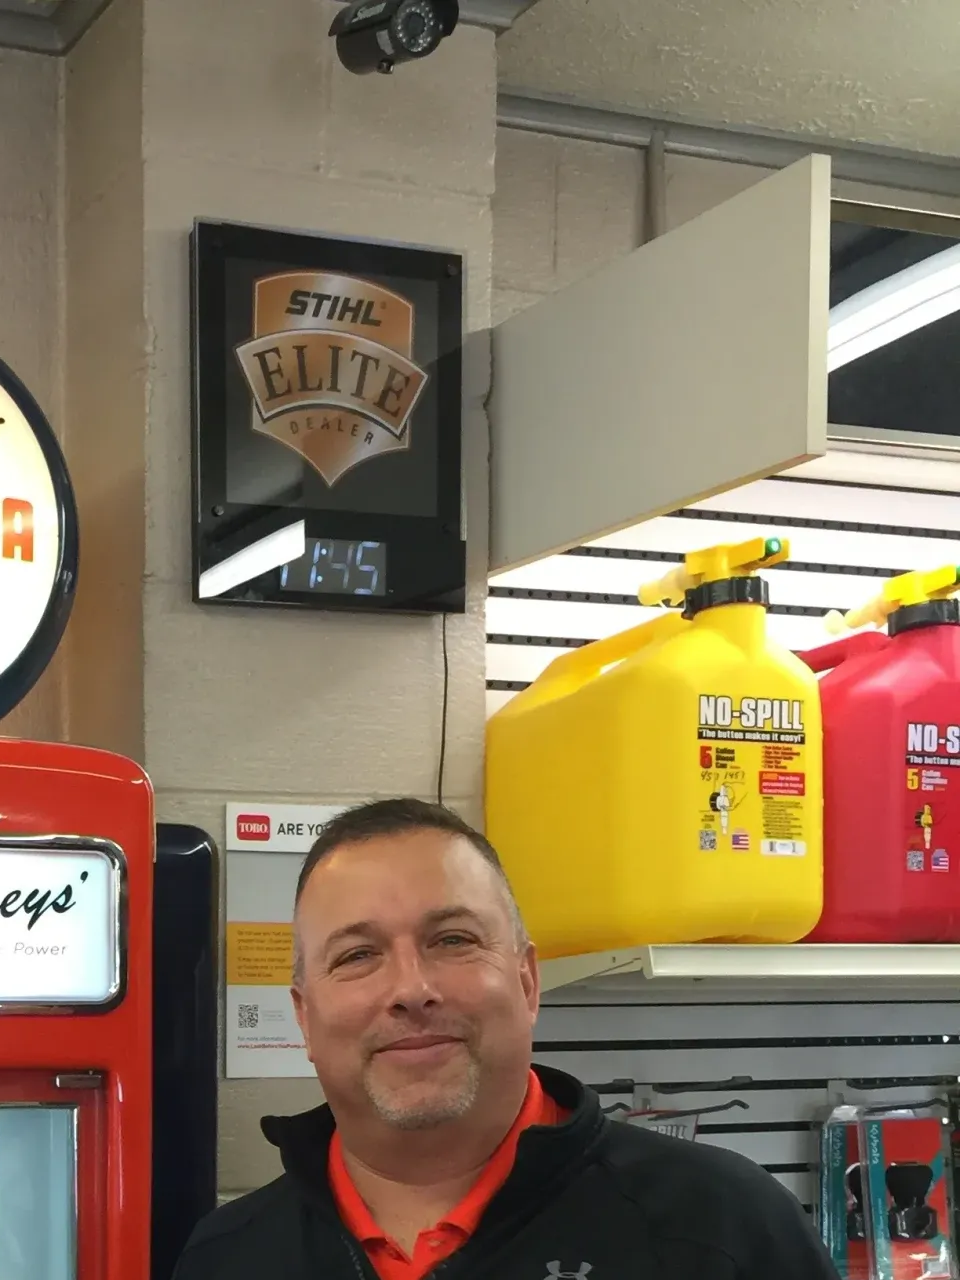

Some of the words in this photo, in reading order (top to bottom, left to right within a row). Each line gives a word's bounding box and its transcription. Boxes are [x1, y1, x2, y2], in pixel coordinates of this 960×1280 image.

[285, 290, 382, 326] STIHL
[253, 344, 411, 418] ELITE
[290, 415, 375, 446] DEALER
[699, 694, 804, 731] NO-SPILL
[717, 730, 744, 739] button
[745, 732, 770, 741] makes
[772, 733, 778, 741] it
[700, 746, 713, 769] 5
[924, 756, 948, 766] button
[907, 768, 919, 790] 5
[239, 822, 268, 834] TORO
[277, 823, 304, 836] ARE
[307, 823, 325, 836] YO
[14, 941, 67, 956] Power
[870, 1124, 880, 1164] Kubota
